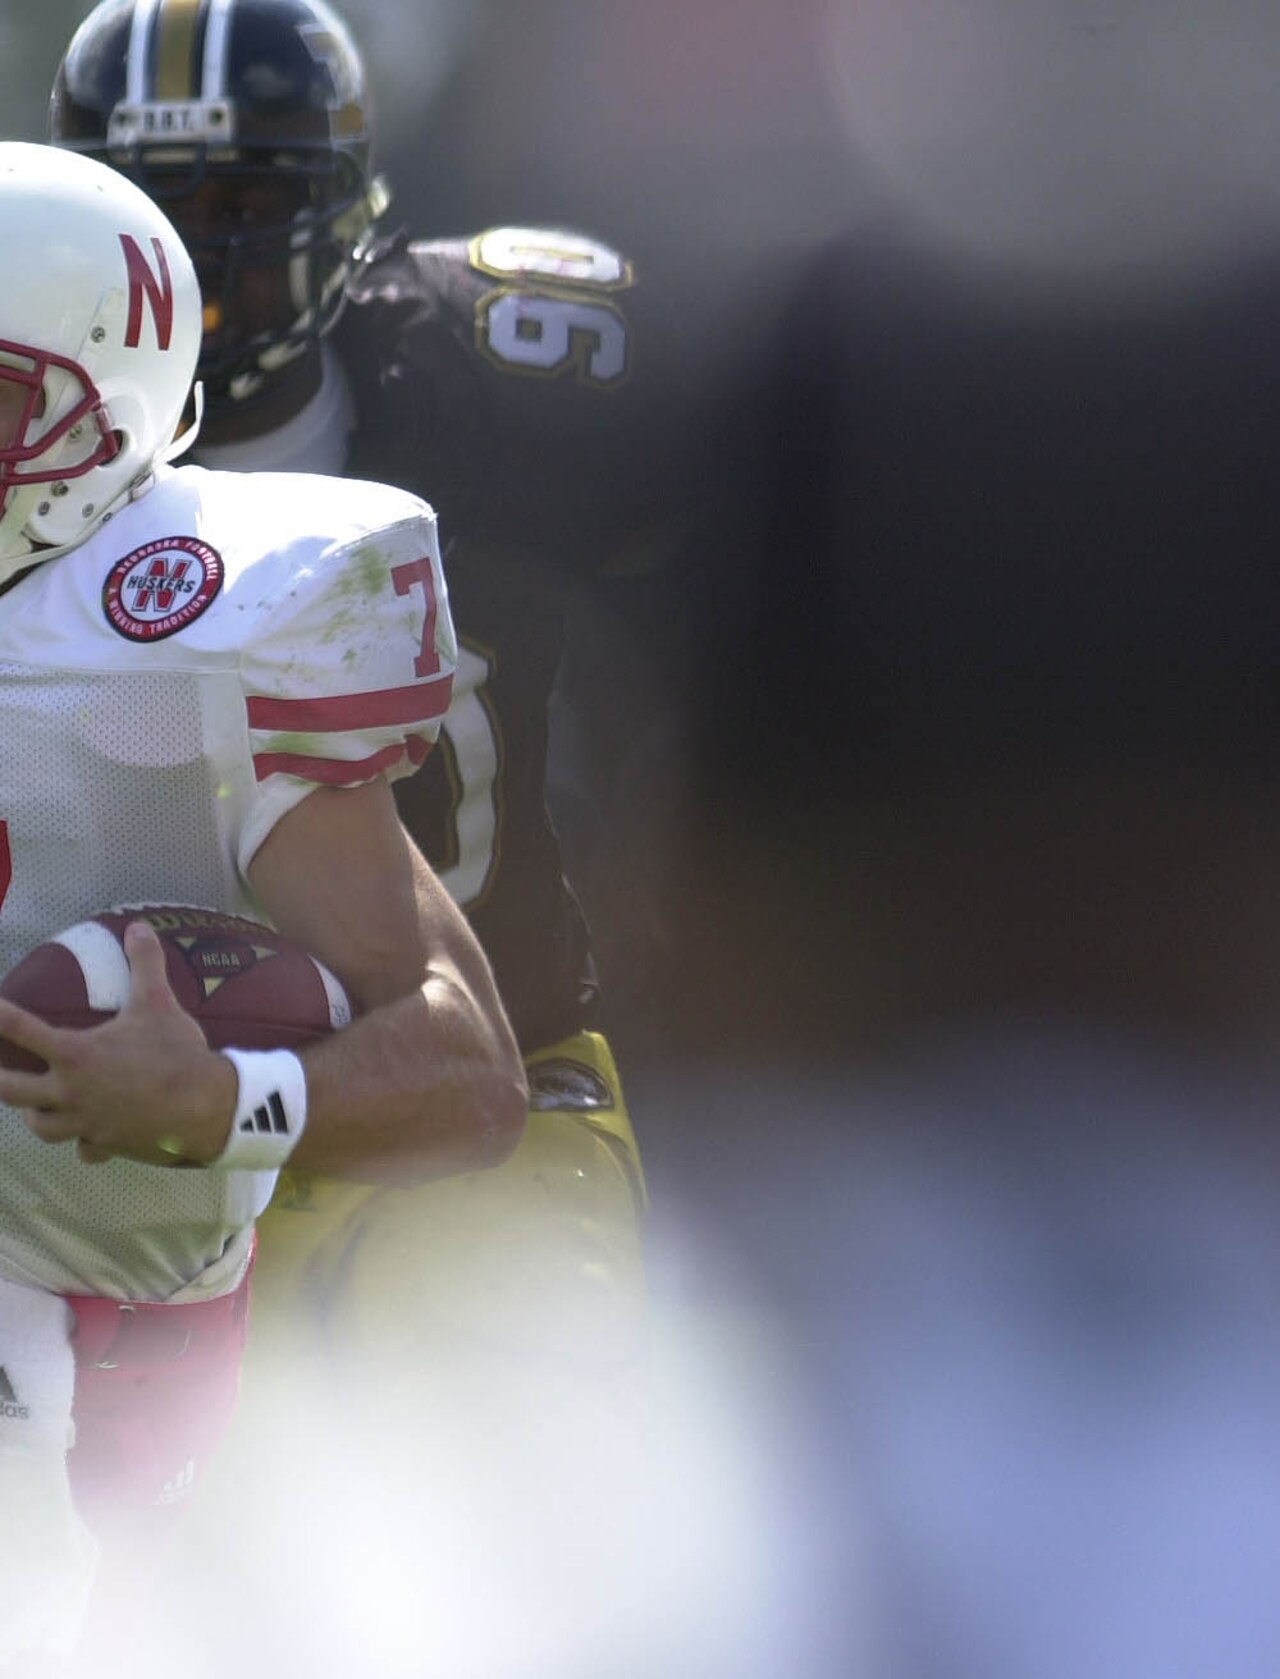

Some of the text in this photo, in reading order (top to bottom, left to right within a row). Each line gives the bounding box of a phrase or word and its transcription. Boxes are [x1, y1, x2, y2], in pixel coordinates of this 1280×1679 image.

[118, 232, 174, 352] N
[126, 575, 195, 594] HUSKERS
[390, 556, 440, 678] 7
[201, 951, 241, 968] NCAA
